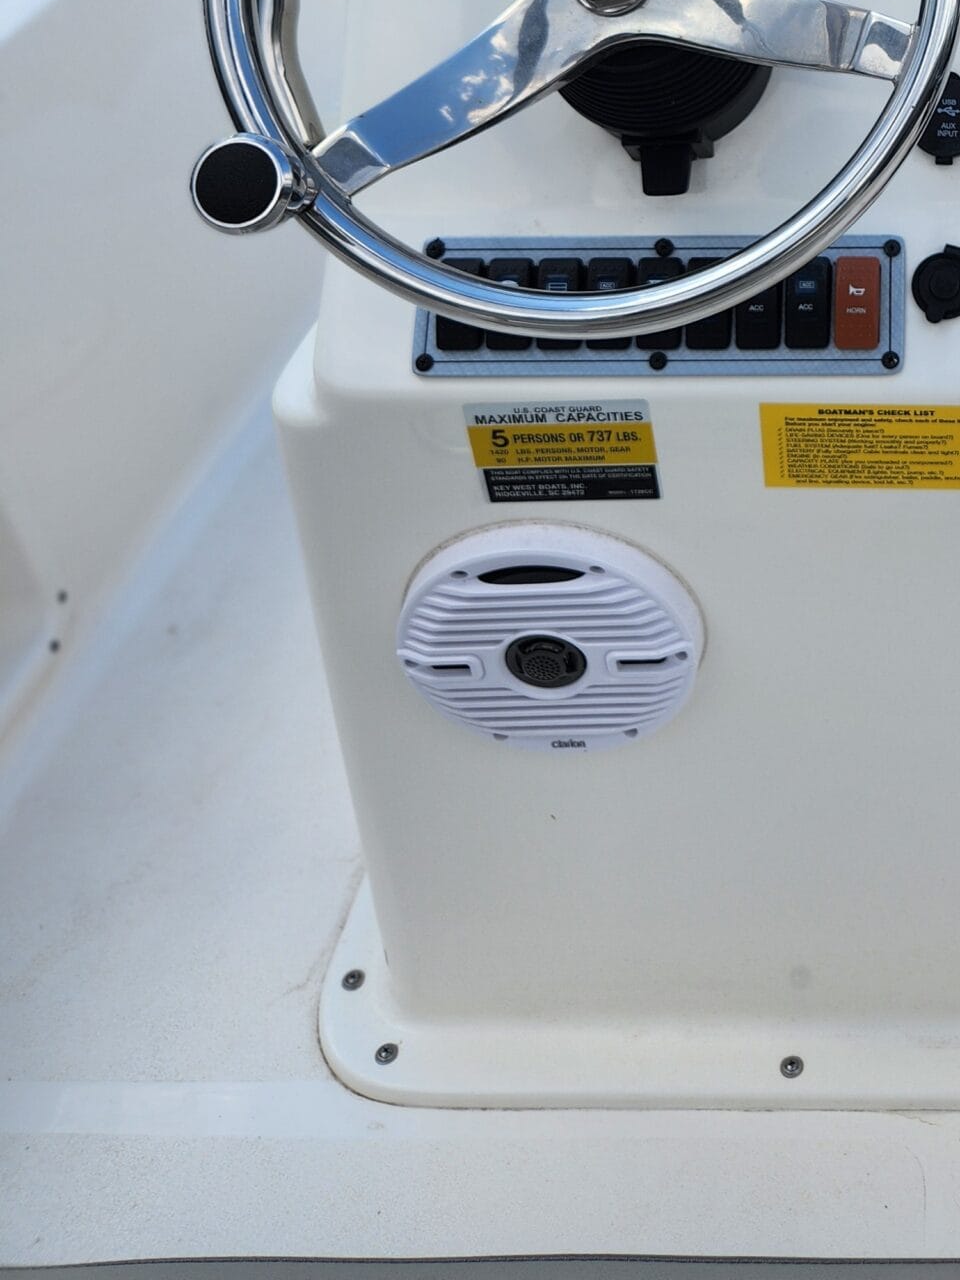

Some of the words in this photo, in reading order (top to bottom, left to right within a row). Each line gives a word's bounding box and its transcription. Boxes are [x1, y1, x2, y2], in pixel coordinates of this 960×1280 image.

[474, 414, 547, 424] MAXIMUM
[556, 411, 644, 422] CAPACITIES
[491, 429, 509, 447] 5
[513, 433, 566, 443] PERSONS
[569, 433, 585, 442] OR
[586, 430, 613, 442] 737
[616, 431, 642, 441] LBS.
